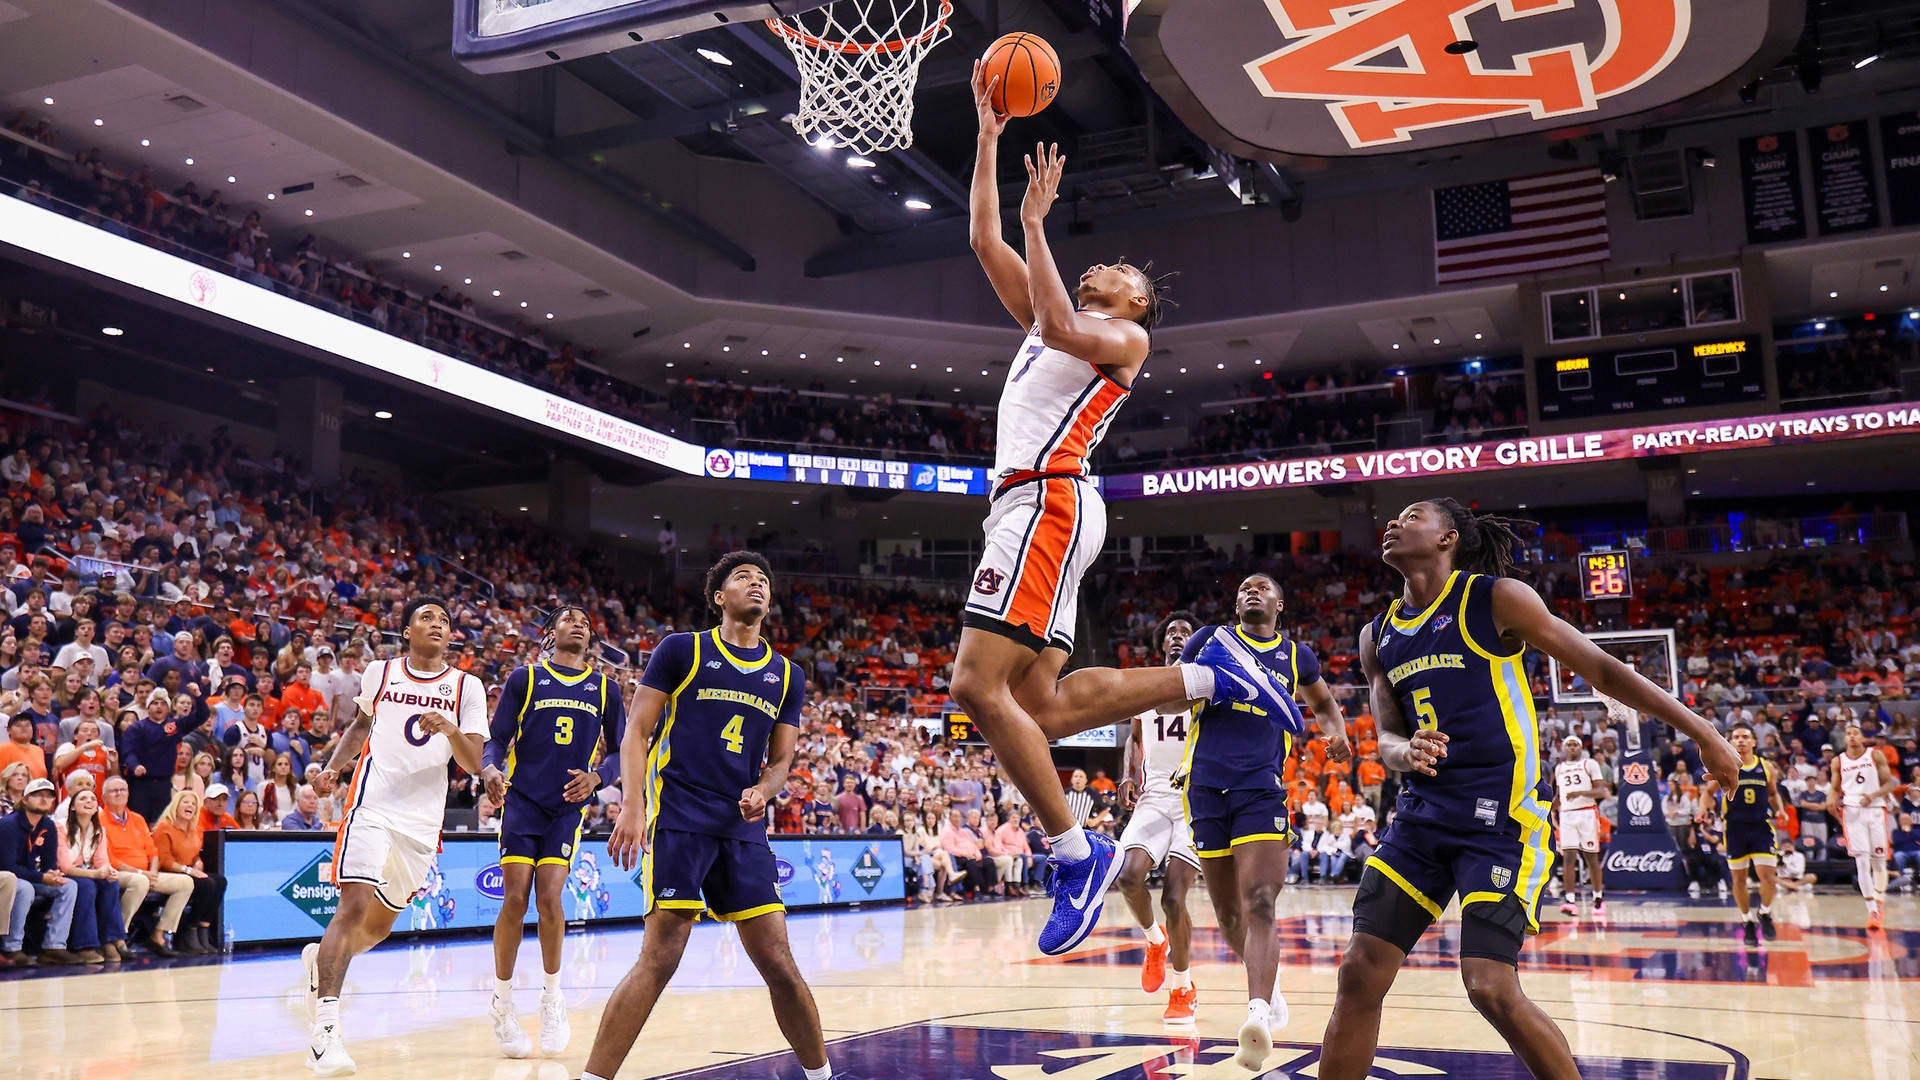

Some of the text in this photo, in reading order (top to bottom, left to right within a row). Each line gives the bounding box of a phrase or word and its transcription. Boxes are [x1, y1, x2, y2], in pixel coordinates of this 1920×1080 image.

[1821, 148, 1860, 162] CIAMPI
[1755, 160, 1786, 172] SMITH
[1693, 341, 1746, 357] MERRIMACK
[1011, 345, 1046, 383] 7
[1556, 358, 1589, 371] AUBURN
[320, 413, 339, 431] 110
[545, 399, 669, 451] THE OFFICIAL EMPLOYEE BENEFITS
[546, 410, 666, 459] PARTNER OF AUBURN ATHLETICS
[1142, 457, 1347, 496] BAUMHOWER'S
[1355, 444, 1483, 478] VICTORY
[1494, 434, 1604, 466] GRILLE
[1632, 421, 1776, 450] PARTY-READY
[1779, 414, 1849, 436] TRAYS
[1851, 412, 1883, 430] TO
[1588, 555, 1625, 570] 14:31
[1589, 568, 1623, 595] 26
[1387, 653, 1466, 688] ERRIMACK
[381, 691, 456, 712] AUBURN
[534, 699, 598, 717] MERRIMACK
[696, 688, 778, 720] MERRIMACK
[1411, 686, 1438, 732] 5
[404, 713, 433, 747] 0
[554, 716, 574, 745] 3
[720, 714, 745, 754] 4
[950, 725, 968, 740] 55
[1154, 716, 1187, 741] 14
[1563, 774, 1582, 787] 33
[1856, 771, 1865, 784] 6
[1743, 788, 1756, 804] 9
[292, 884, 342, 901] Sensigre
[324, 905, 338, 915] 200
